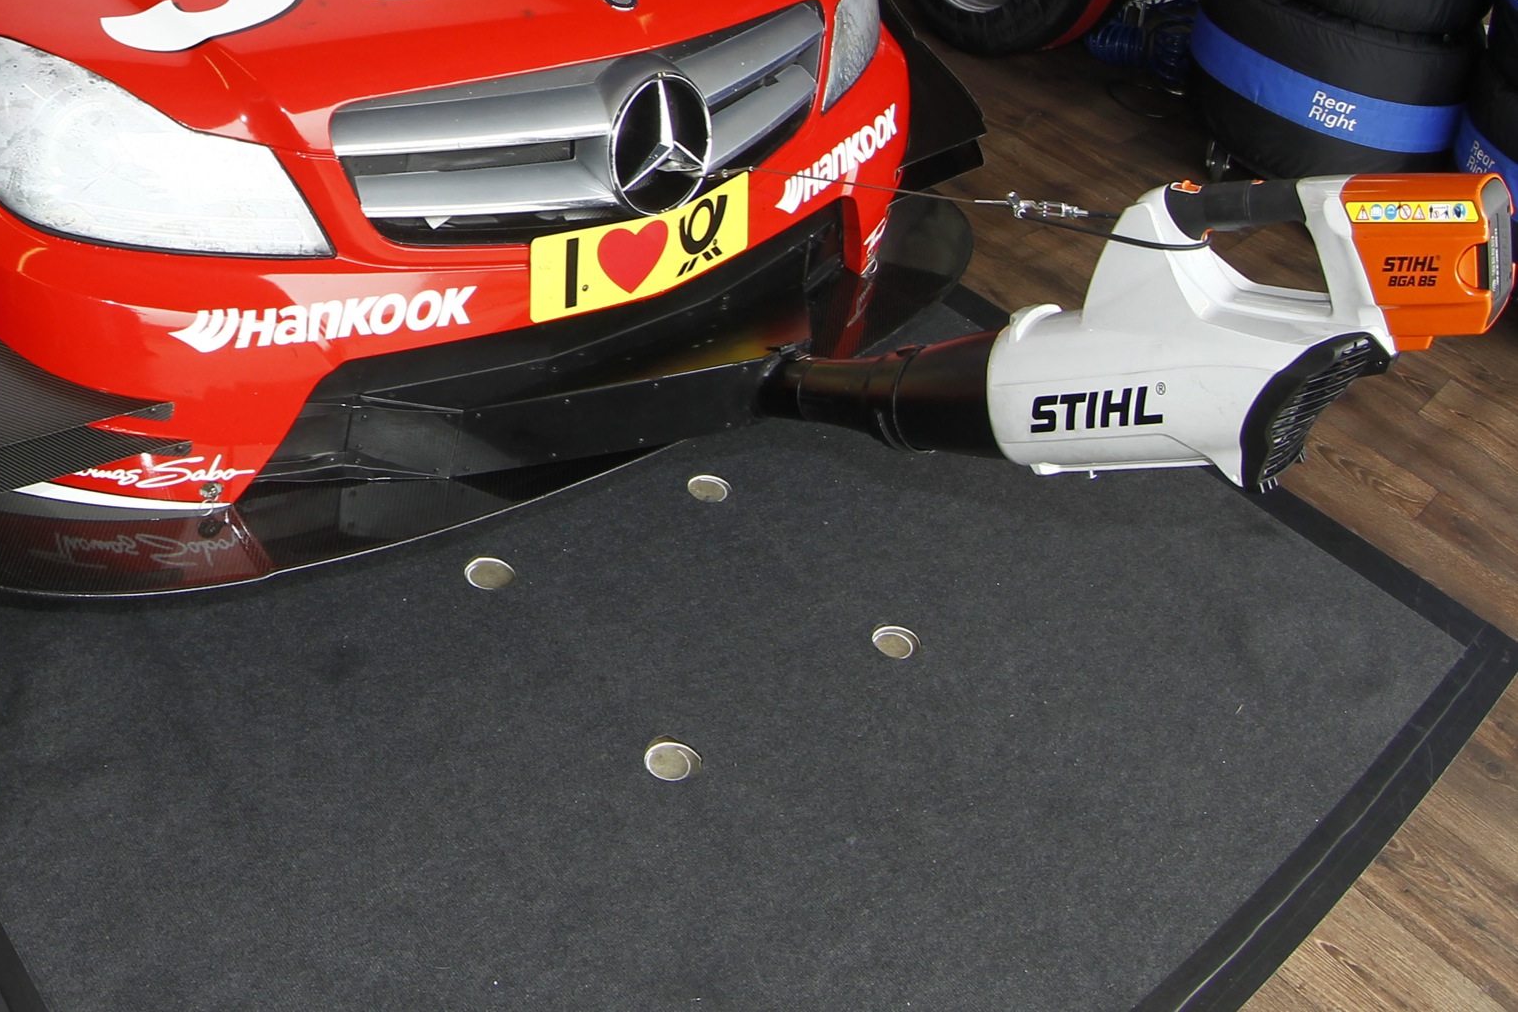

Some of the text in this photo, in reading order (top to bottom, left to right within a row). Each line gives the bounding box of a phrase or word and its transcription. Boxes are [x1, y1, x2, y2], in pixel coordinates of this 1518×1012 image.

[1312, 90, 1356, 115] Rear
[1308, 105, 1358, 132] Right
[1470, 140, 1495, 169] Rear
[565, 238, 579, 309] I
[1382, 255, 1440, 273] STIHL
[1388, 275, 1437, 287] BGA 85
[1030, 386, 1164, 433] STIHL
[135, 454, 255, 488] Sabo
